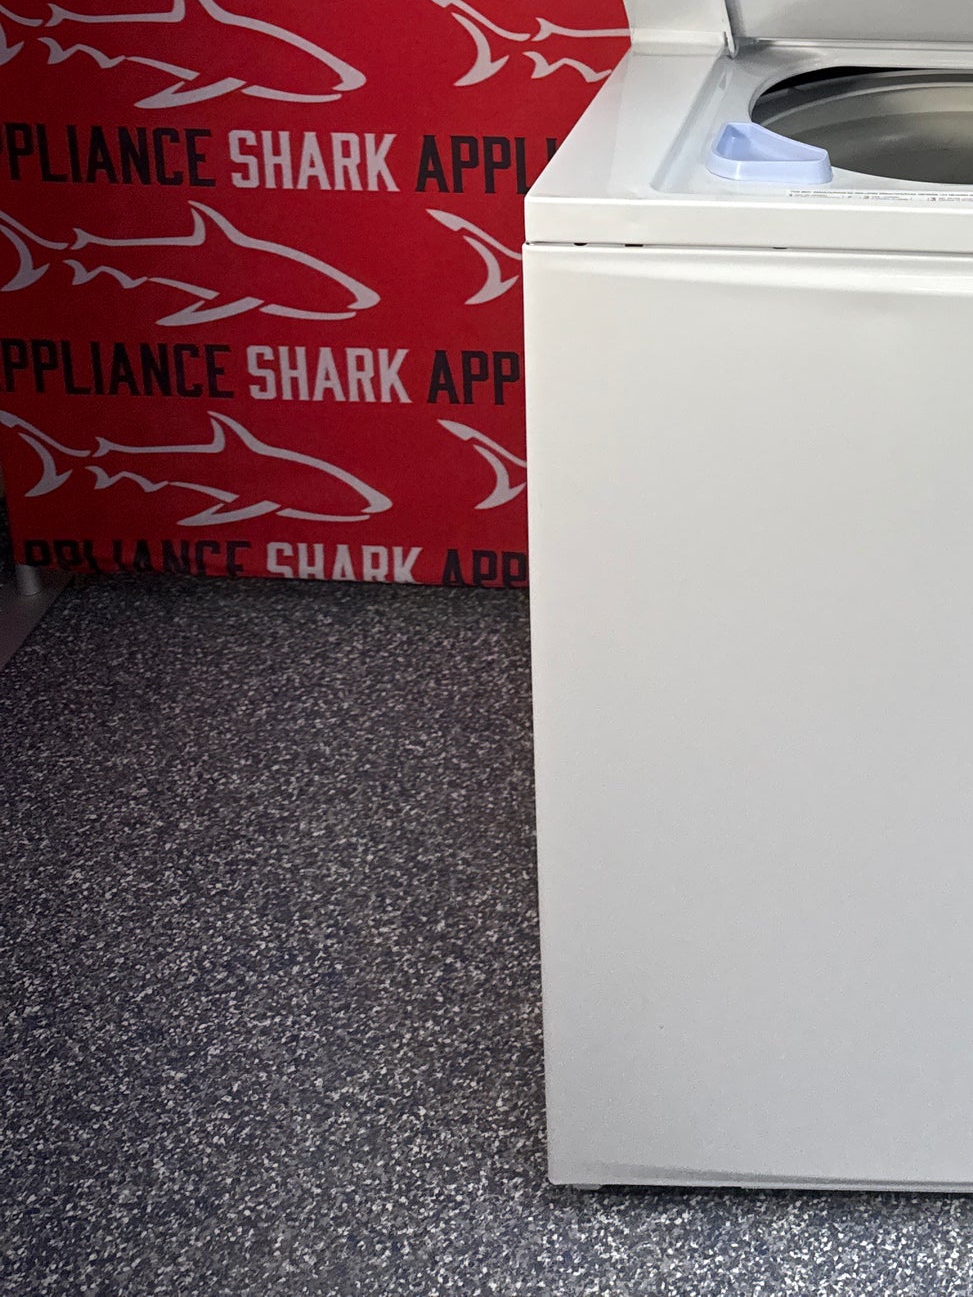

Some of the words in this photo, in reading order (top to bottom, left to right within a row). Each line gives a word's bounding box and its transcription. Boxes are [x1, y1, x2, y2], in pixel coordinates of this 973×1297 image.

[0, 122, 215, 187] PLIANCE
[230, 130, 401, 192] SHARK
[247, 345, 413, 404] SHARK
[427, 349, 520, 405] APP
